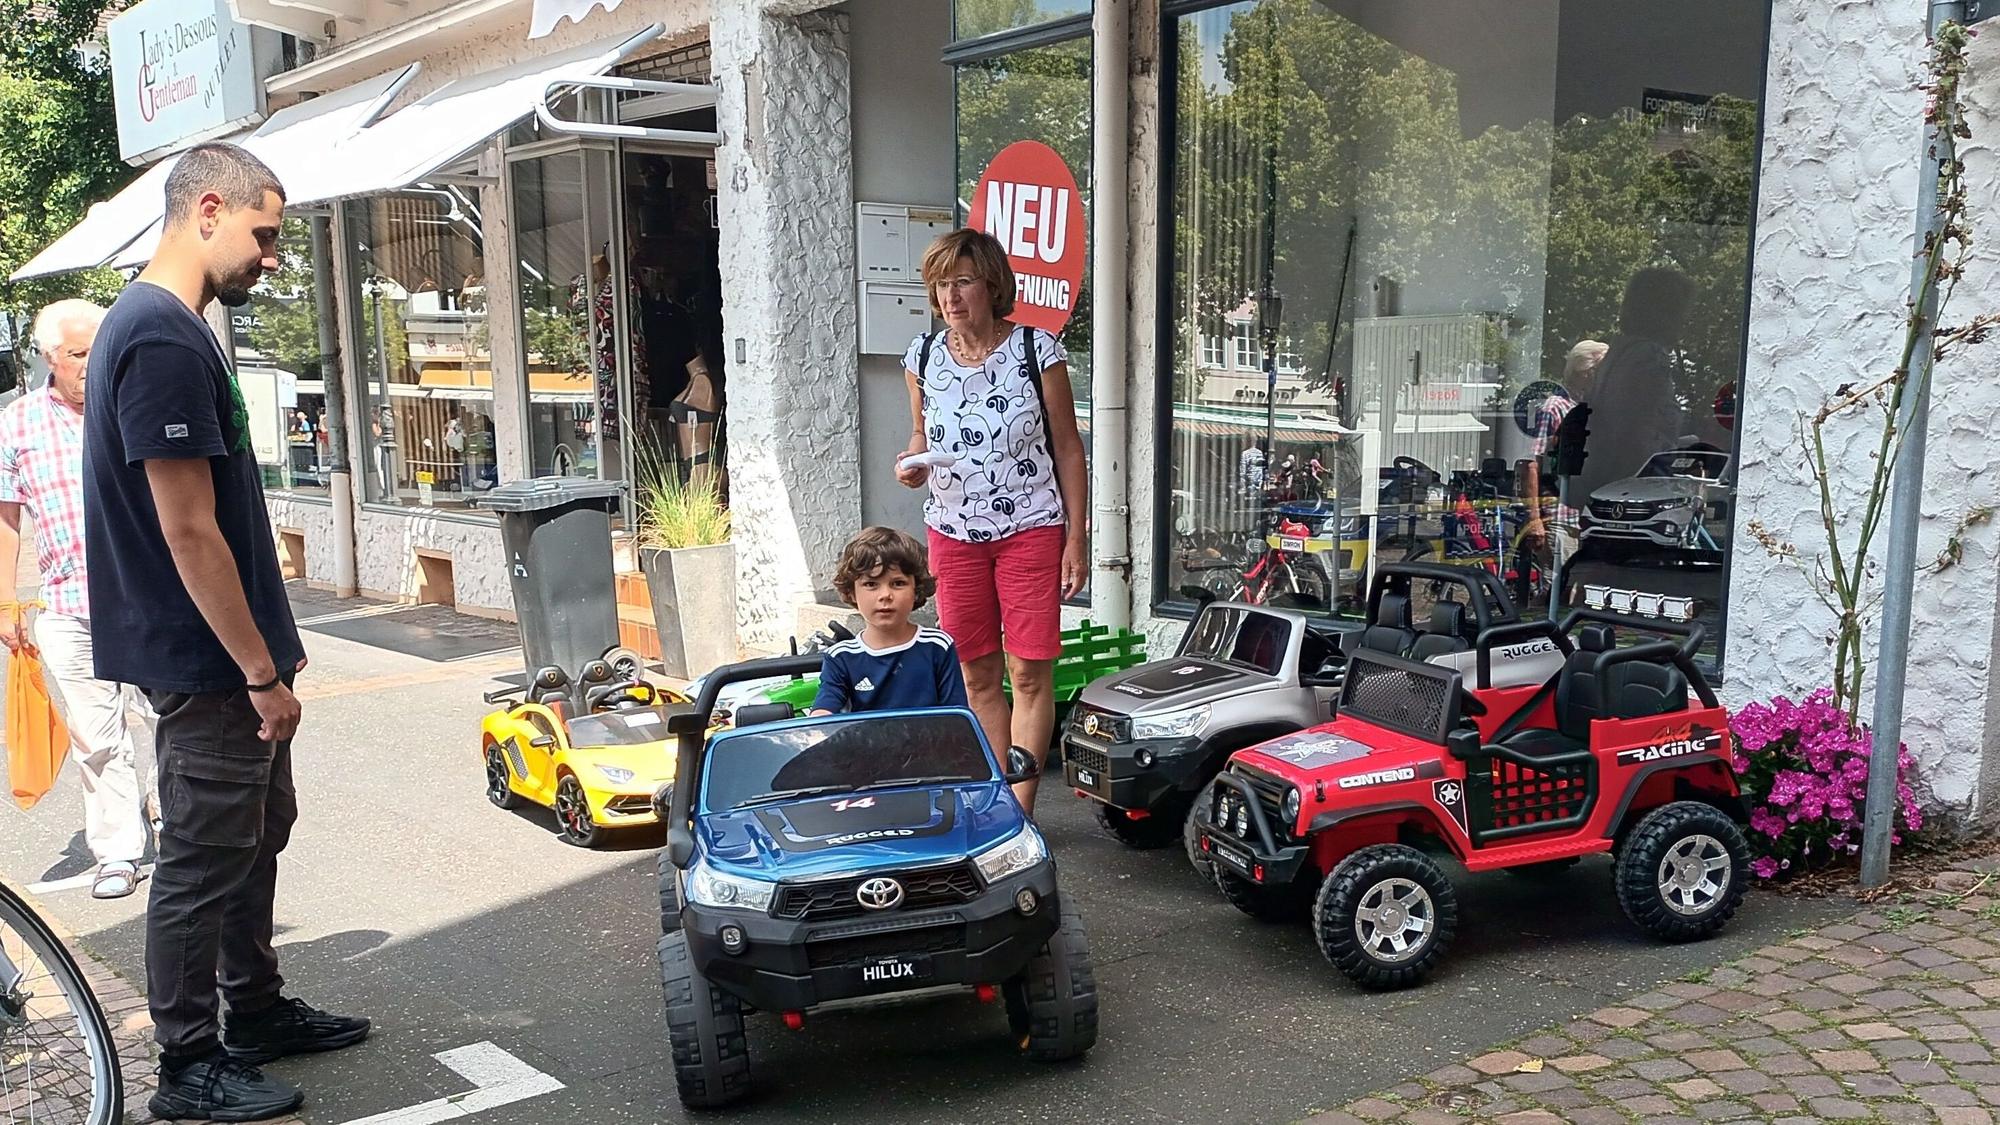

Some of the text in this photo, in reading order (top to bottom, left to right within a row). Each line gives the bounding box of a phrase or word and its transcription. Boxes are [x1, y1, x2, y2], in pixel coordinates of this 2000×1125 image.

[175, 14, 217, 53] Dessous
[204, 27, 237, 109] OUTLET
[139, 64, 197, 122] Gentleman
[985, 180, 1070, 264] NEU
[1014, 272, 1070, 311] FNUNG
[1339, 768, 1415, 788] CONTEND
[825, 829, 915, 845] RUGGED
[863, 963, 914, 981] HILUX
